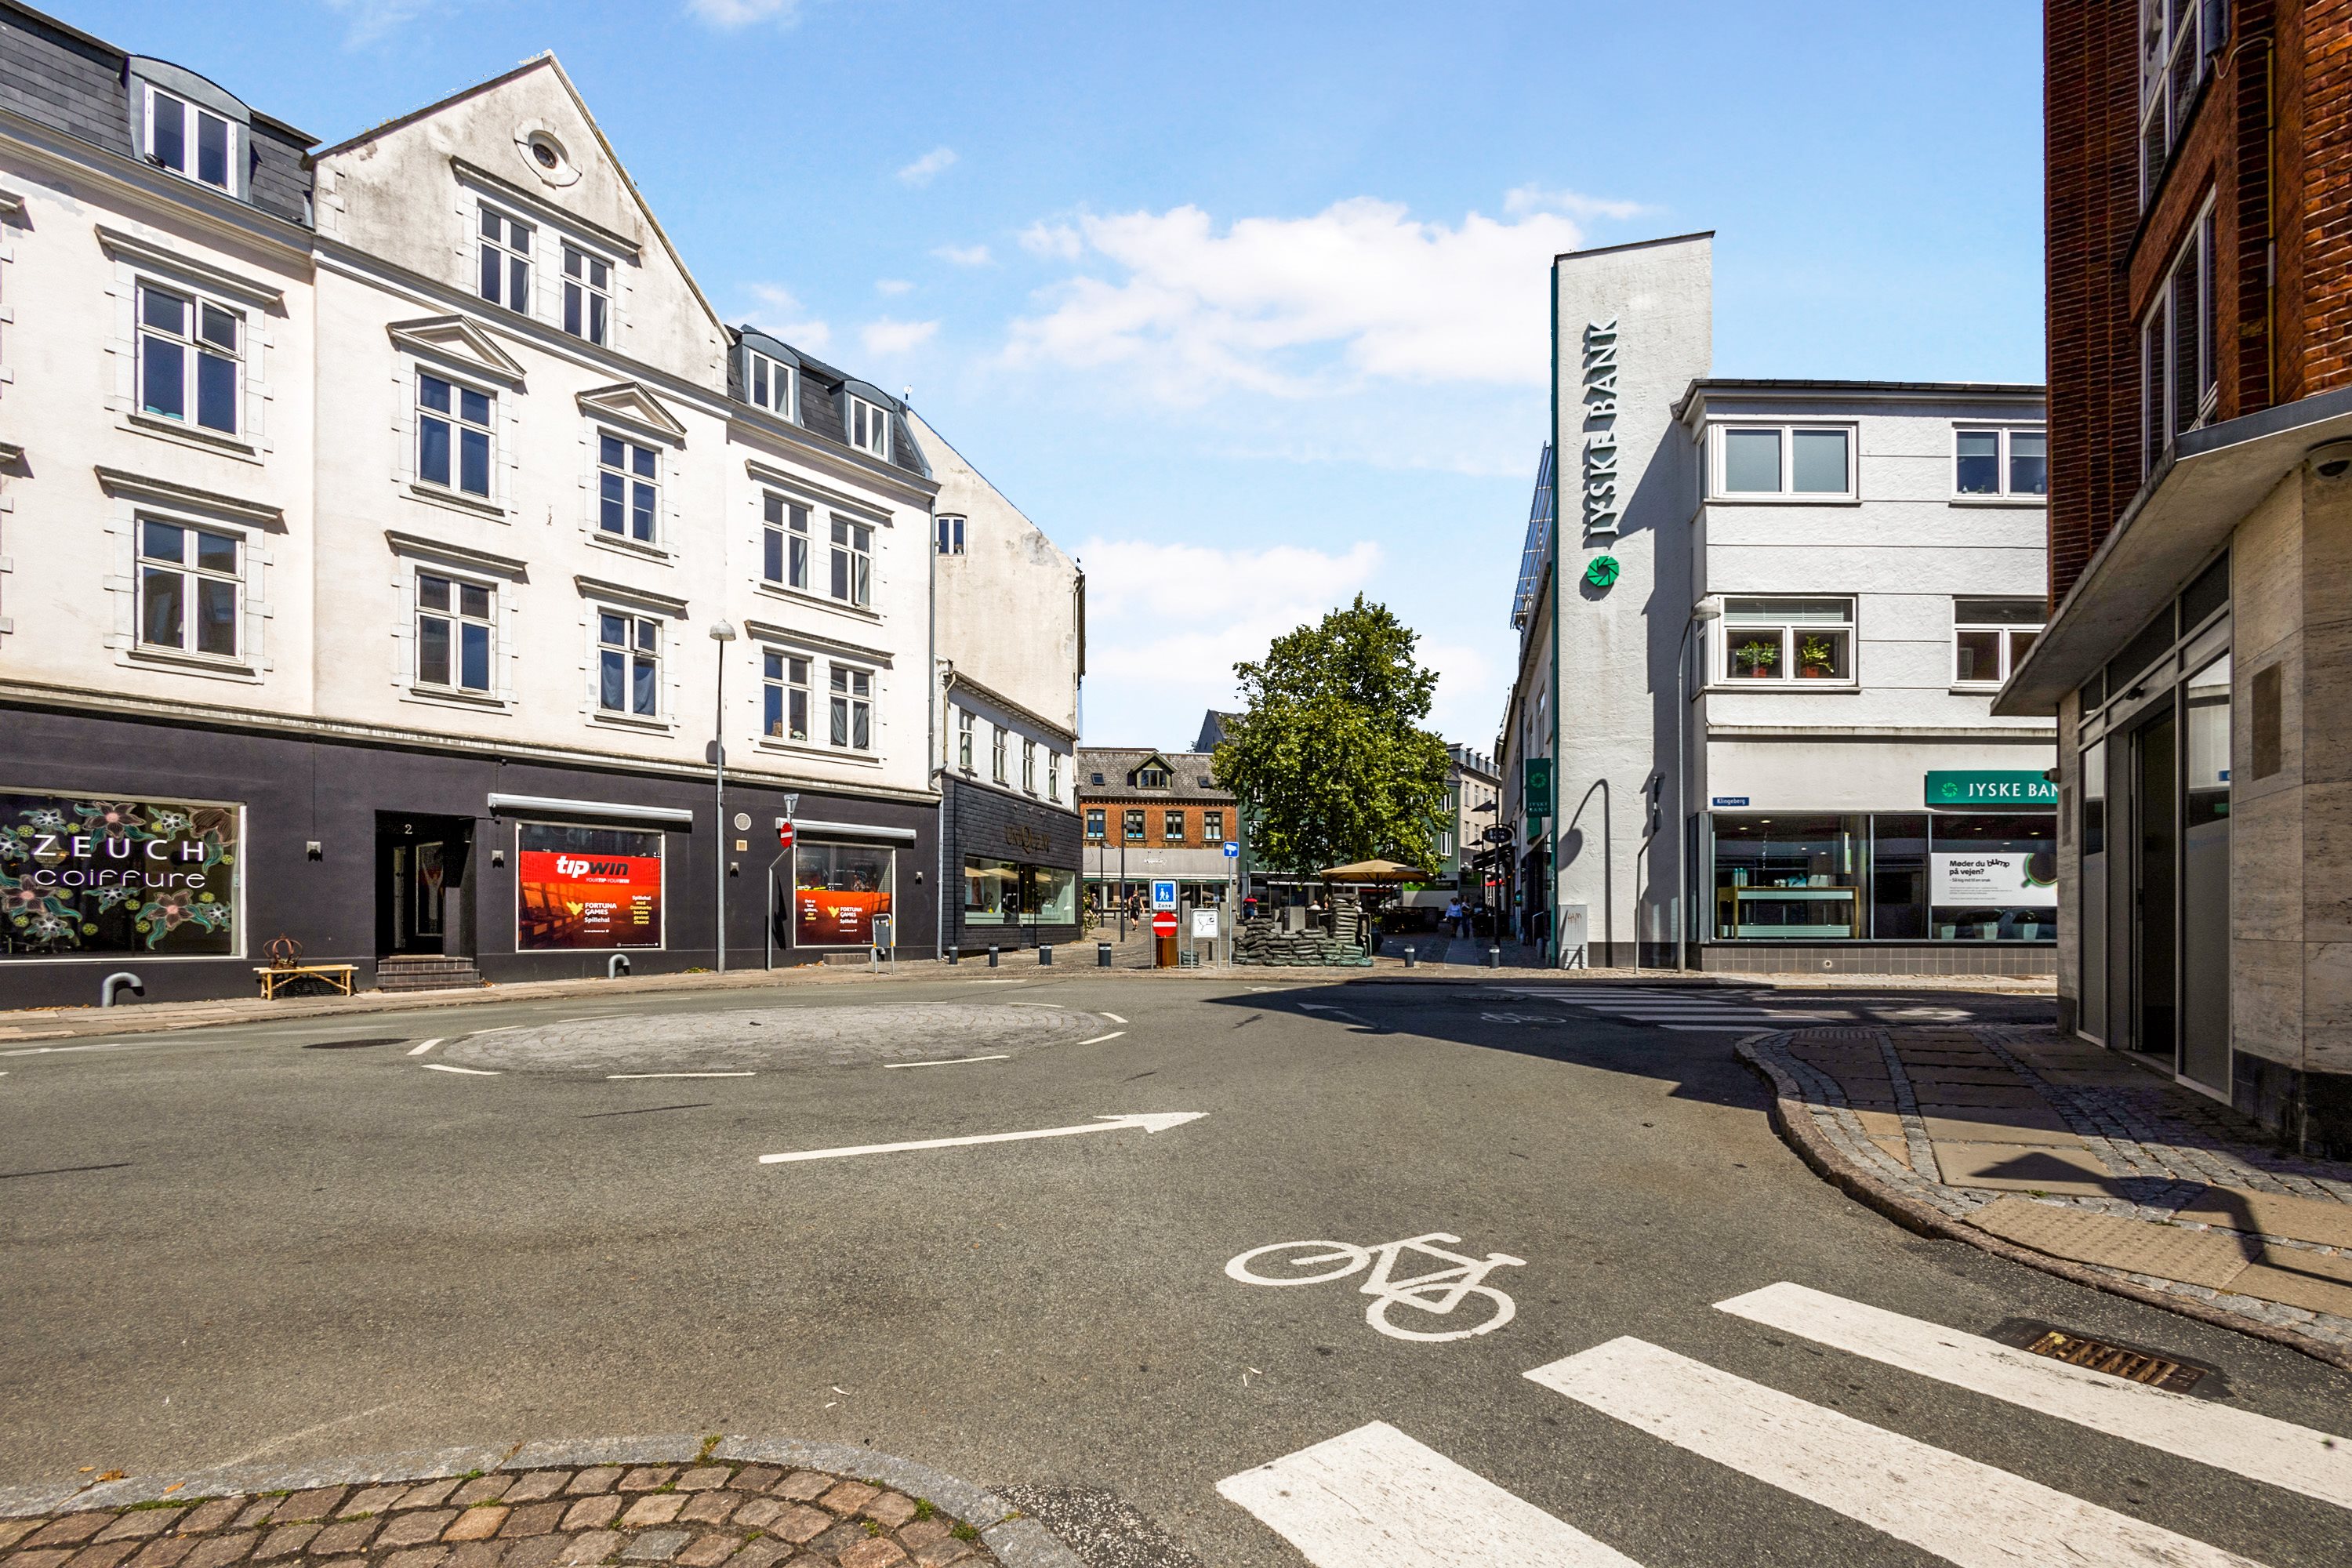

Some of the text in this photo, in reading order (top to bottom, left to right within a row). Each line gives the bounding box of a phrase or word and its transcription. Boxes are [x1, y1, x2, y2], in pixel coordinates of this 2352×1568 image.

[1590, 315, 1619, 536] JYSKE BANK
[1969, 783, 2058, 797] JYSKE BAN
[405, 824, 412, 834] 2
[33, 834, 204, 862] ZEUCH
[556, 855, 630, 878] tipwin
[1987, 858, 2010, 868] bump
